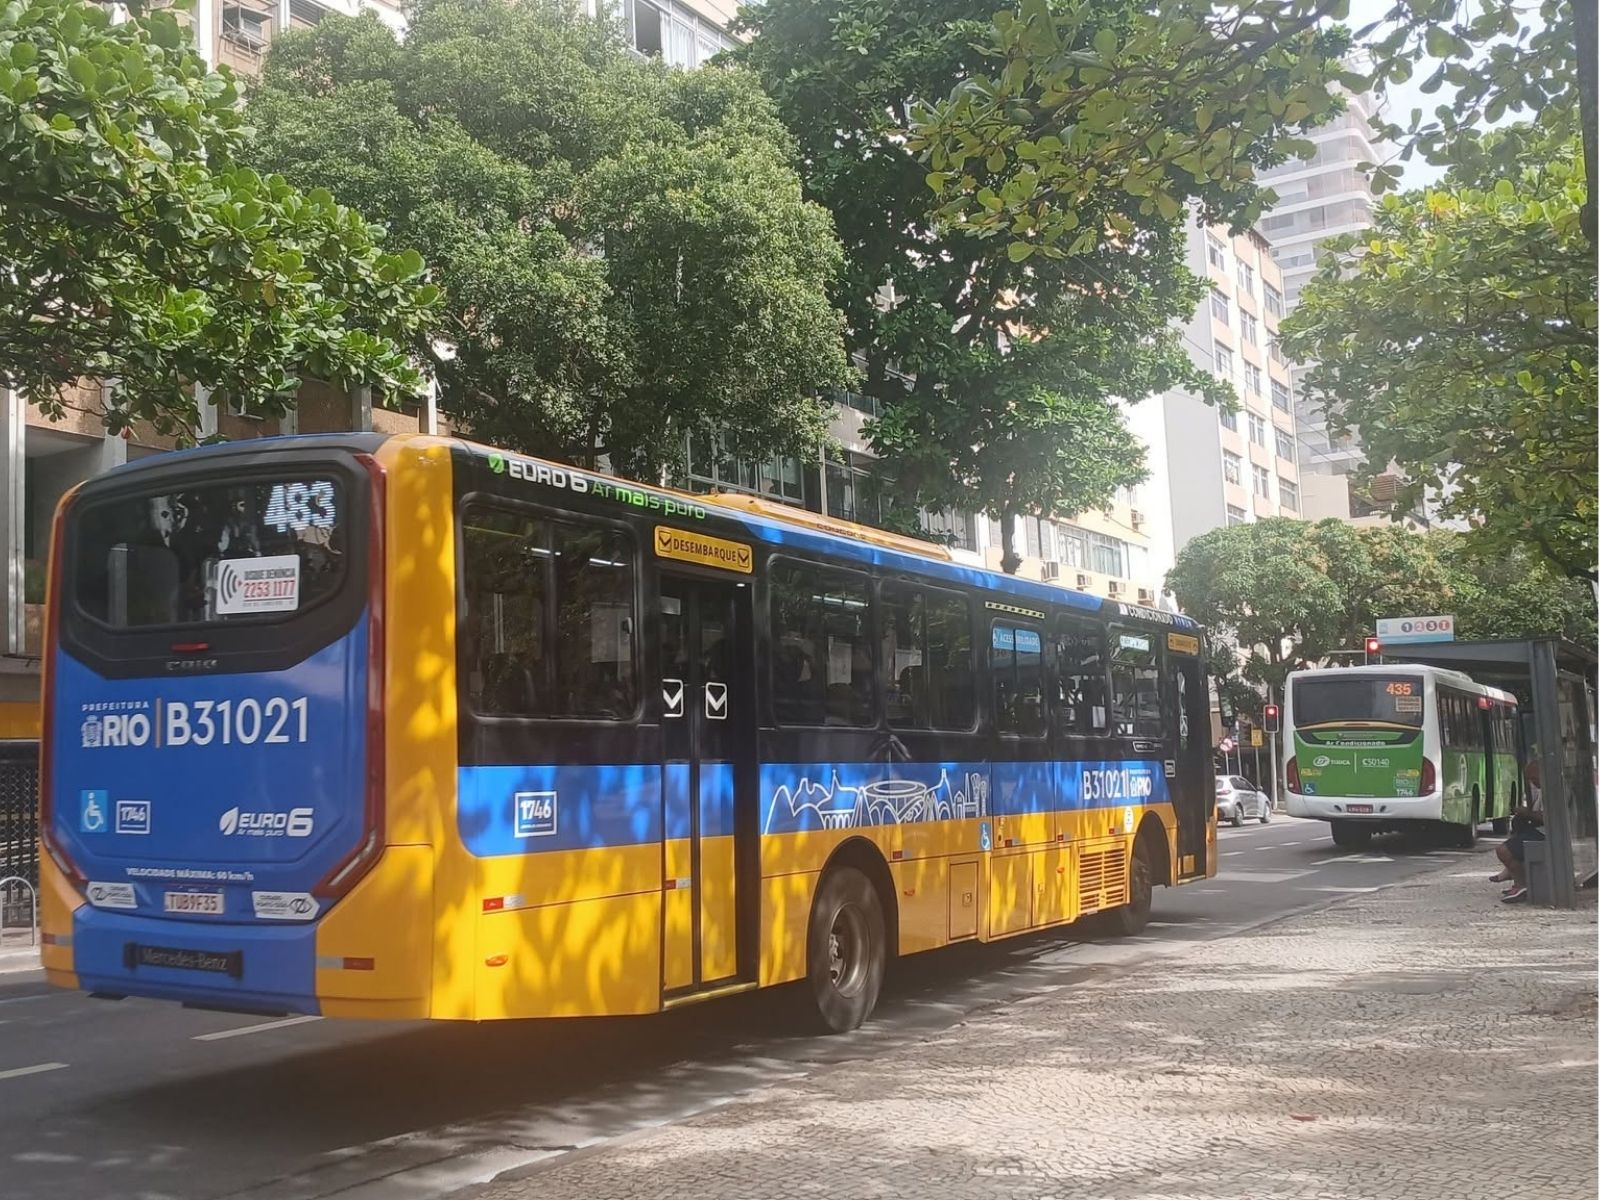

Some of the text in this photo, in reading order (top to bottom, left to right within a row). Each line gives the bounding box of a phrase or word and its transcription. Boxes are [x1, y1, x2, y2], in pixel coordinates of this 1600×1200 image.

[508, 460, 706, 519] EURO 6 Ar mais puro
[263, 480, 336, 533] 483
[673, 538, 738, 562] DESEMBARQUE
[244, 580, 295, 598] 2253 1177
[1386, 683, 1412, 696] 435
[82, 701, 150, 712] PREFEITURA
[103, 697, 308, 746] RIO B31021
[1362, 757, 1390, 768] C50140
[1083, 769, 1152, 801] B31021 RIO
[120, 806, 146, 821] 1746
[520, 799, 552, 820] 1746
[239, 807, 314, 837] EURO 6
[126, 867, 175, 878] VELOCIDADE
[176, 869, 215, 879] MÁXIMA:
[228, 870, 254, 881] km/h
[168, 893, 218, 912] TUB9F35
[143, 947, 227, 971] Mercedes-Benz
